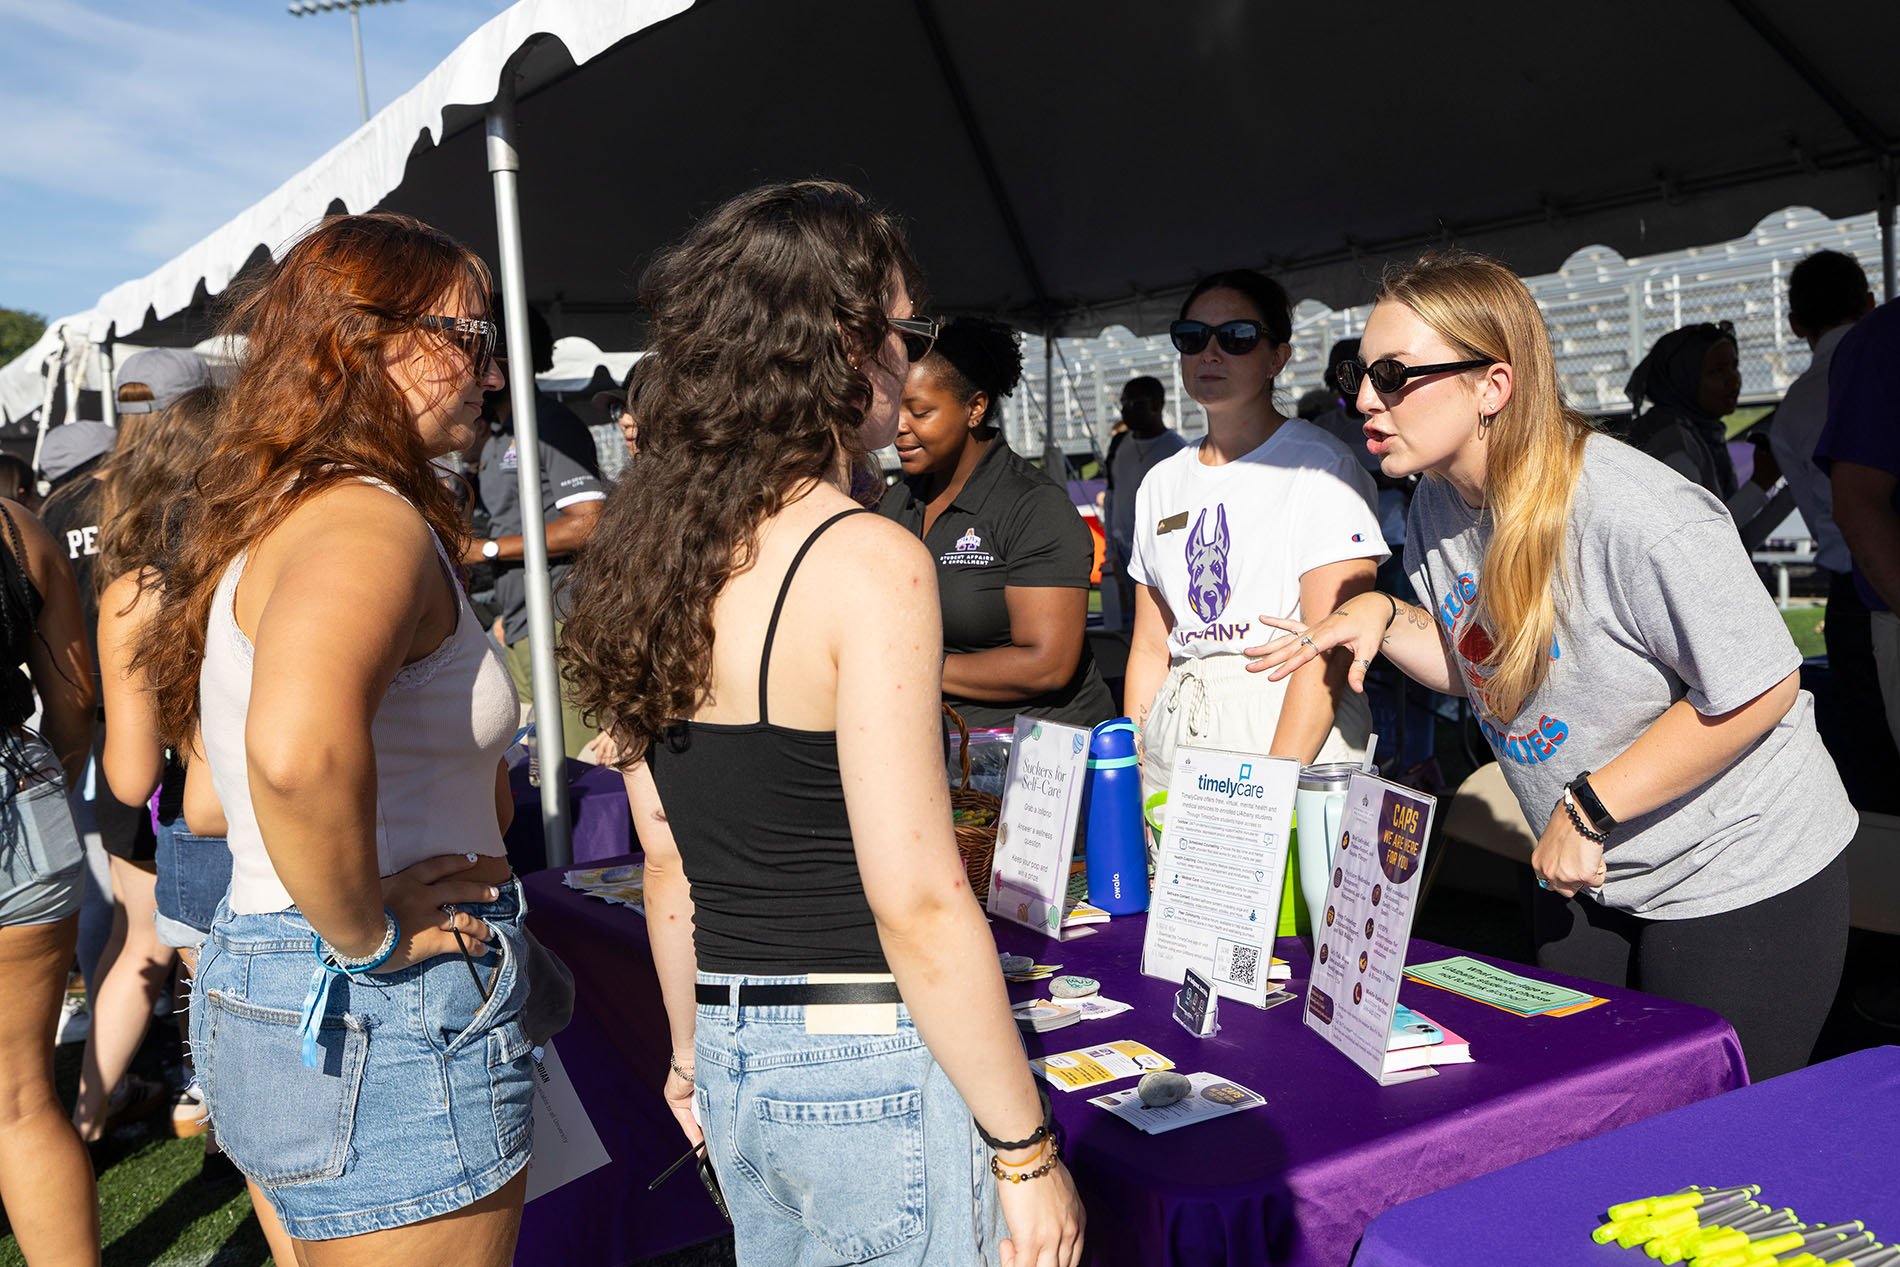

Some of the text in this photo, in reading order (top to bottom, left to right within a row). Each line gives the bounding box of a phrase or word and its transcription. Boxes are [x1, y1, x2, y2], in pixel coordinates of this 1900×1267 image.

[1022, 758, 1067, 783] Suckers for
[1021, 775, 1062, 799] Self-Care
[1181, 792, 1203, 802] TimelyCare
[1198, 774, 1264, 799] timelycare
[1024, 802, 1033, 812] Grab
[1393, 803, 1420, 834] CAPS
[1017, 822, 1032, 833] Answer
[1035, 829, 1052, 840] wellness
[1023, 837, 1041, 849] question
[1383, 829, 1393, 845] WE
[1393, 833, 1405, 850] ARE
[1404, 839, 1419, 856] HERE
[1011, 854, 1021, 864] Keep
[1022, 858, 1030, 866] your
[1040, 864, 1048, 872] and
[1386, 849, 1397, 865] FOR
[1396, 856, 1409, 870] YOU
[1112, 873, 1121, 899] owala
[553, 1117, 569, 1144] University
